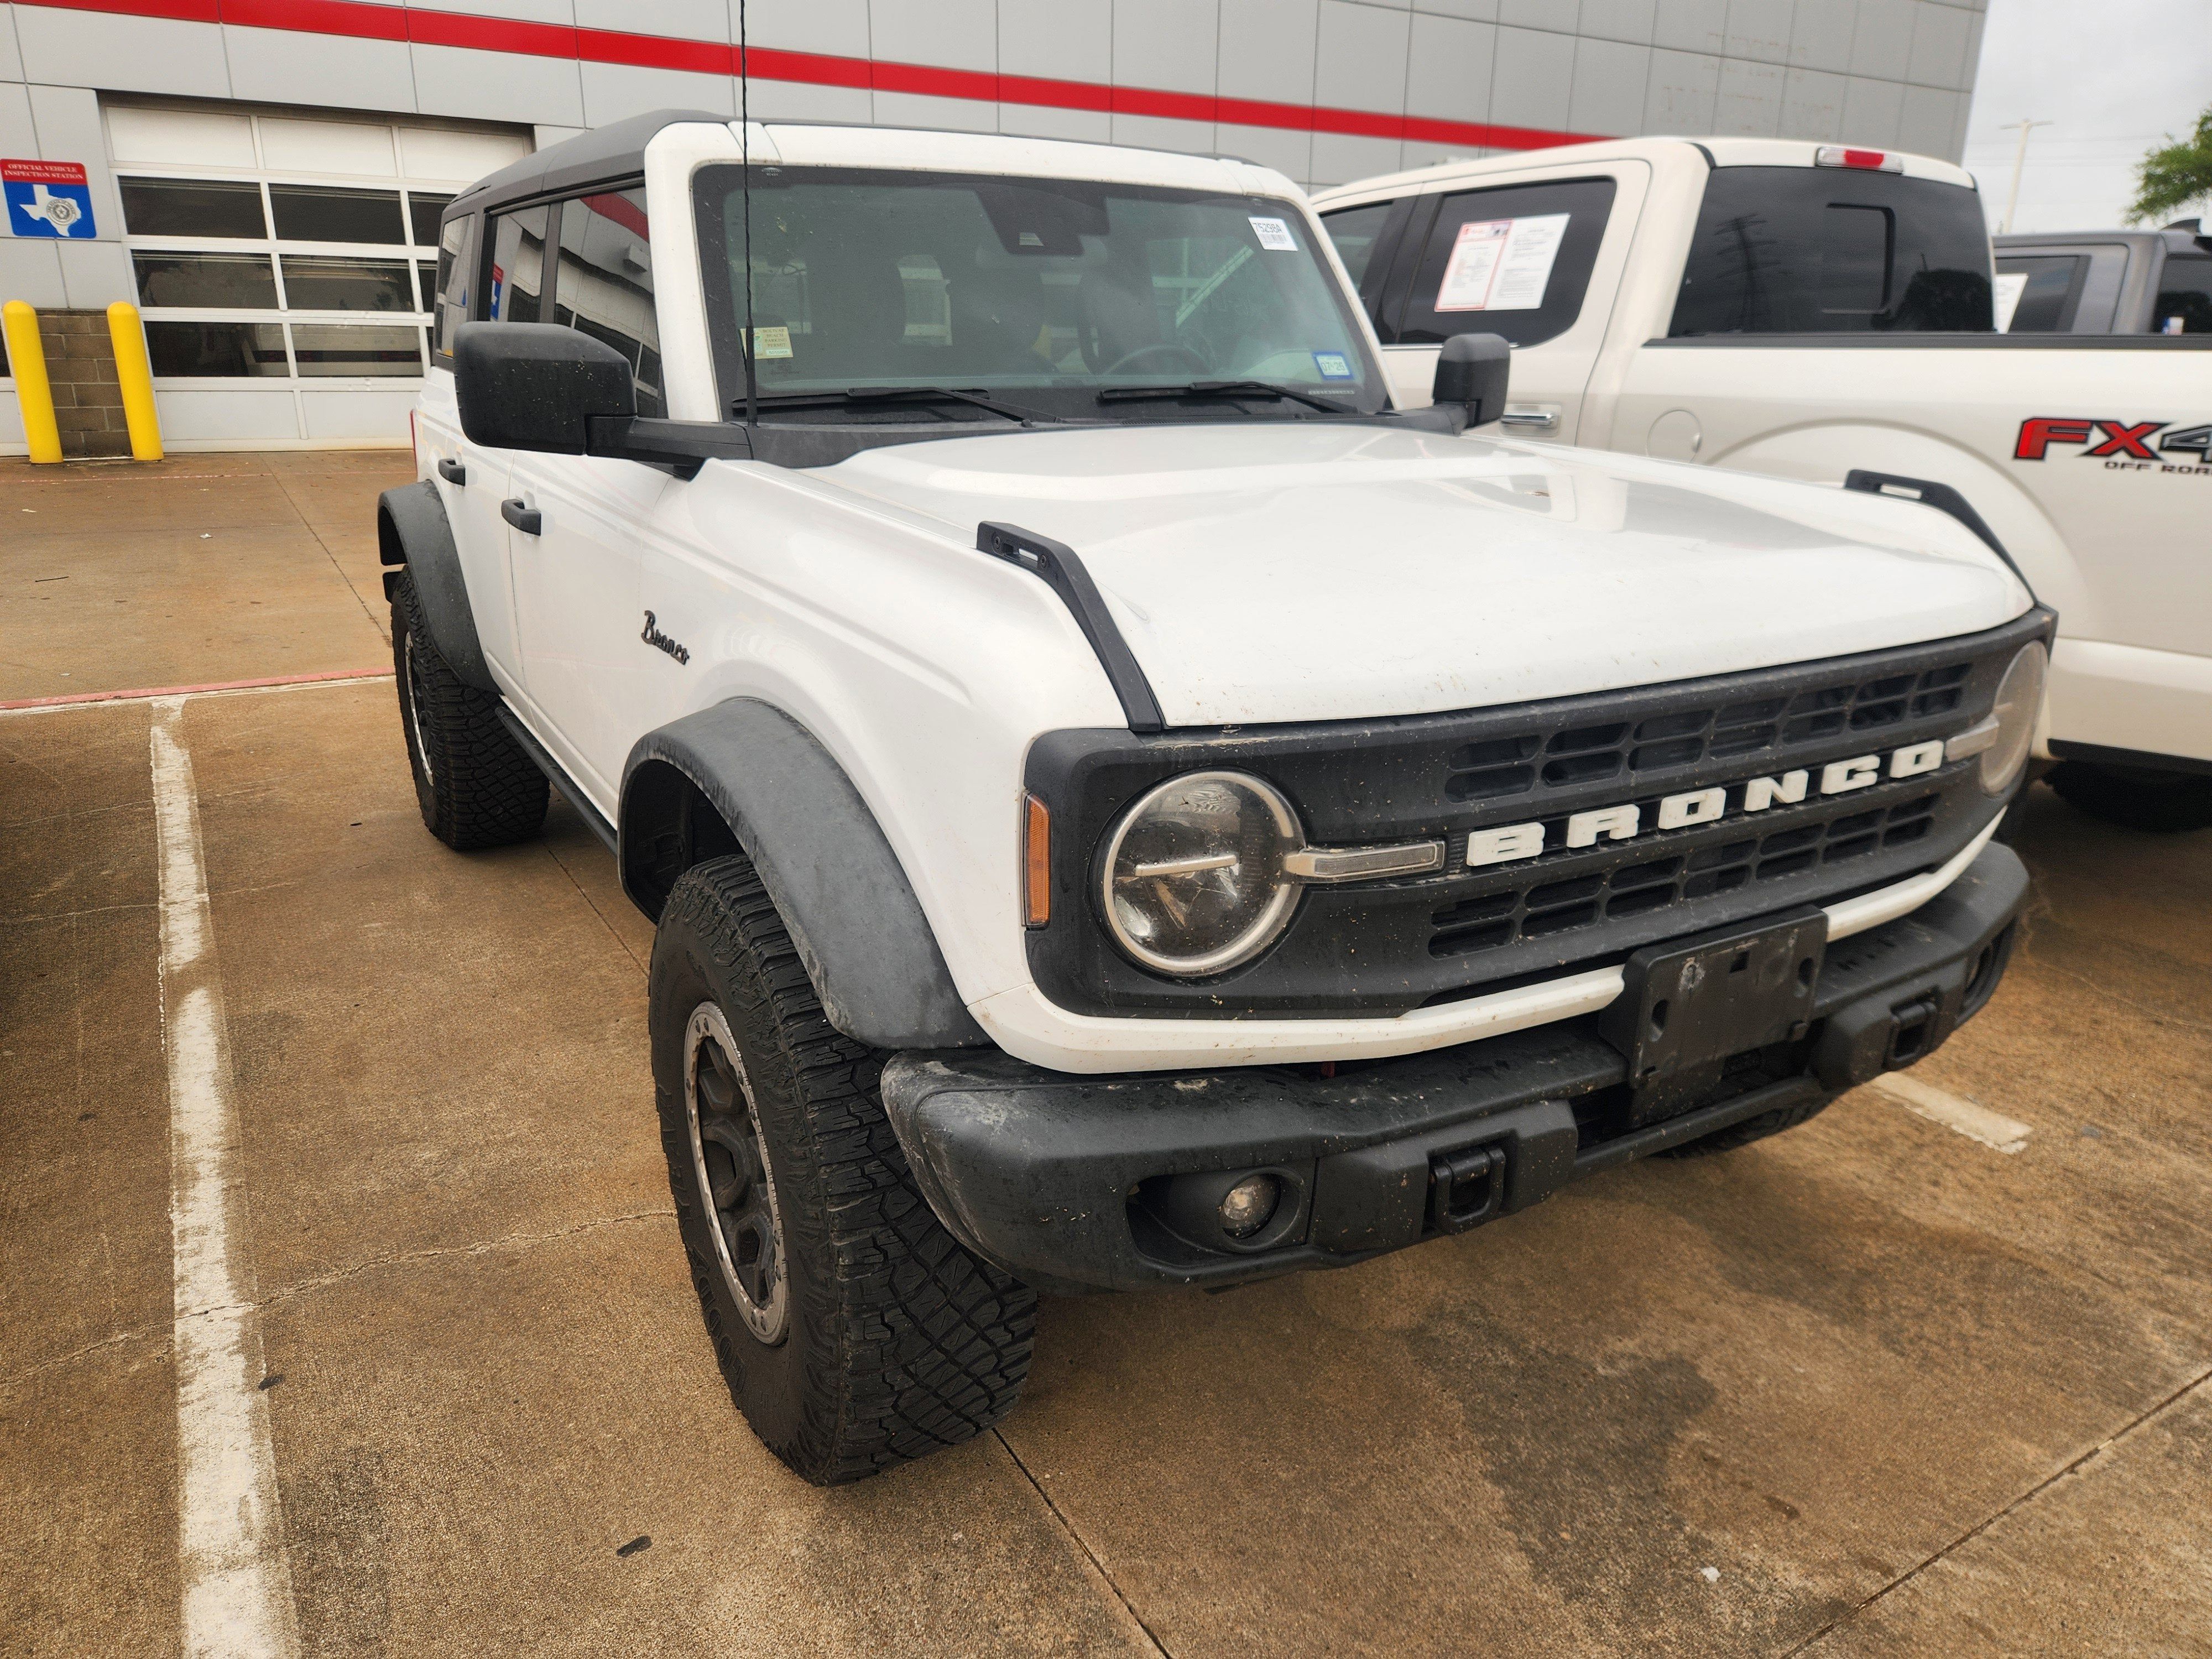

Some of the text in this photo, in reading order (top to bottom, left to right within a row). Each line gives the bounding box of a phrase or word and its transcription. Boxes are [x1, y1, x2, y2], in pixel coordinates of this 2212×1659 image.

[1253, 222, 1283, 233] 75298A
[2014, 417, 2212, 463] FX4
[2104, 461, 2151, 471] OFF
[641, 610, 690, 665] Bronco
[1466, 739, 1944, 867] BRONCO
